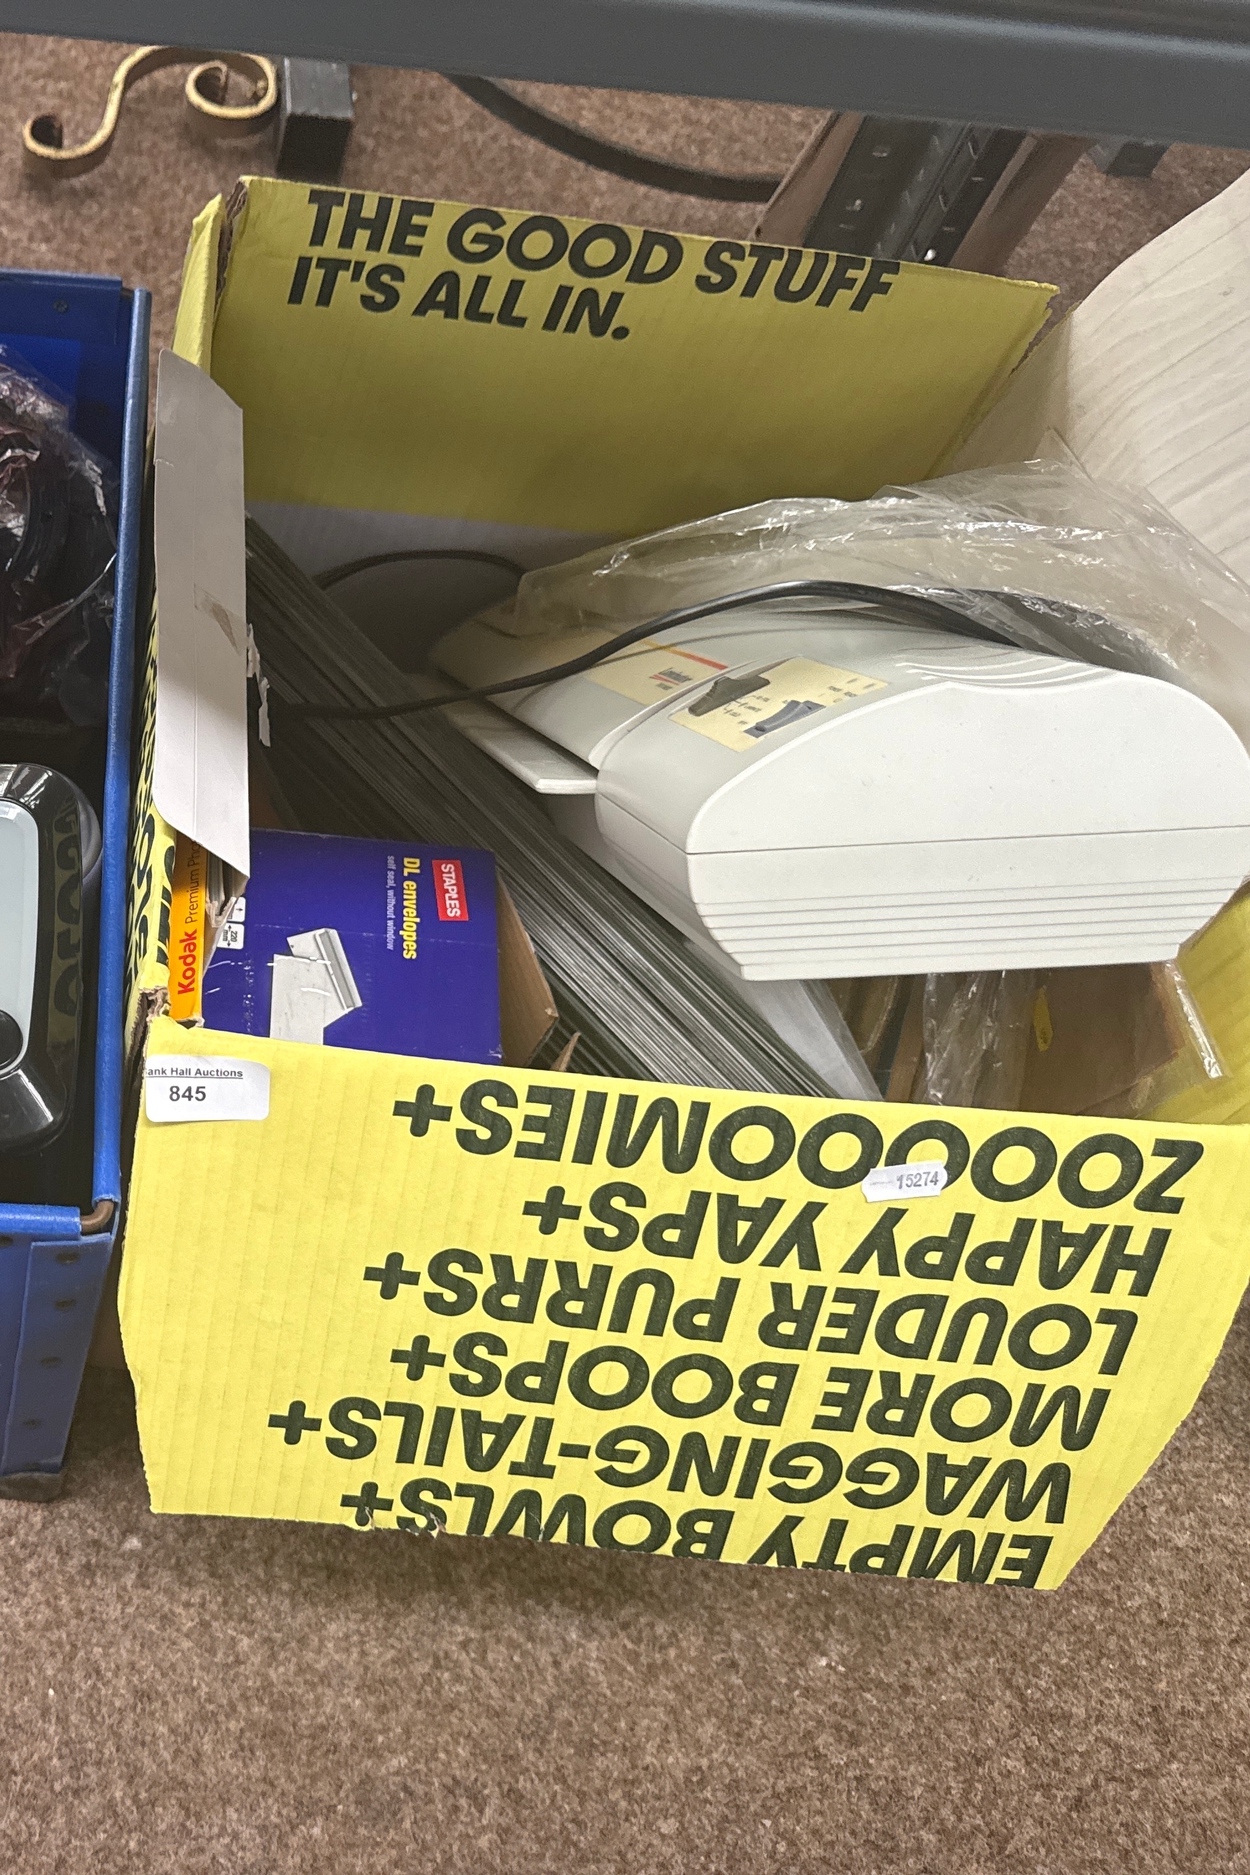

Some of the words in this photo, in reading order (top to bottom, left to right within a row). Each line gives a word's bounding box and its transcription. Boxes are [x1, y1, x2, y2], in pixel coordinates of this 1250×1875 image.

[306, 190, 435, 259] THE
[446, 208, 684, 285] GOOD
[693, 241, 902, 313] STUFF
[286, 257, 407, 315] IT'S
[412, 270, 528, 330] ALL
[540, 285, 631, 342] IN.
[184, 871, 200, 925] Premium
[386, 855, 397, 870] self
[402, 857, 421, 877] DL
[440, 863, 462, 918] STAPLES
[386, 889, 397, 918] without
[386, 919, 397, 951] window
[399, 880, 421, 960] envelopes
[177, 928, 198, 996] Kodak
[146, 1067, 168, 1077] ank
[170, 1067, 192, 1077] Hall
[194, 1068, 244, 1078] Auctions
[169, 1085, 207, 1102] 845
[896, 1171, 940, 1190] 15274
[520, 1181, 828, 1272] YAPS+
[843, 1211, 1172, 1298] HAPPY
[363, 1245, 744, 1344] PURRS+
[758, 1281, 1139, 1377] LOUDER
[390, 1330, 800, 1423] BOOPS+
[815, 1364, 1110, 1454] MORE
[267, 1394, 1073, 1527] WAGGING-TAILS+
[748, 1514, 1054, 1589] EMPTY
